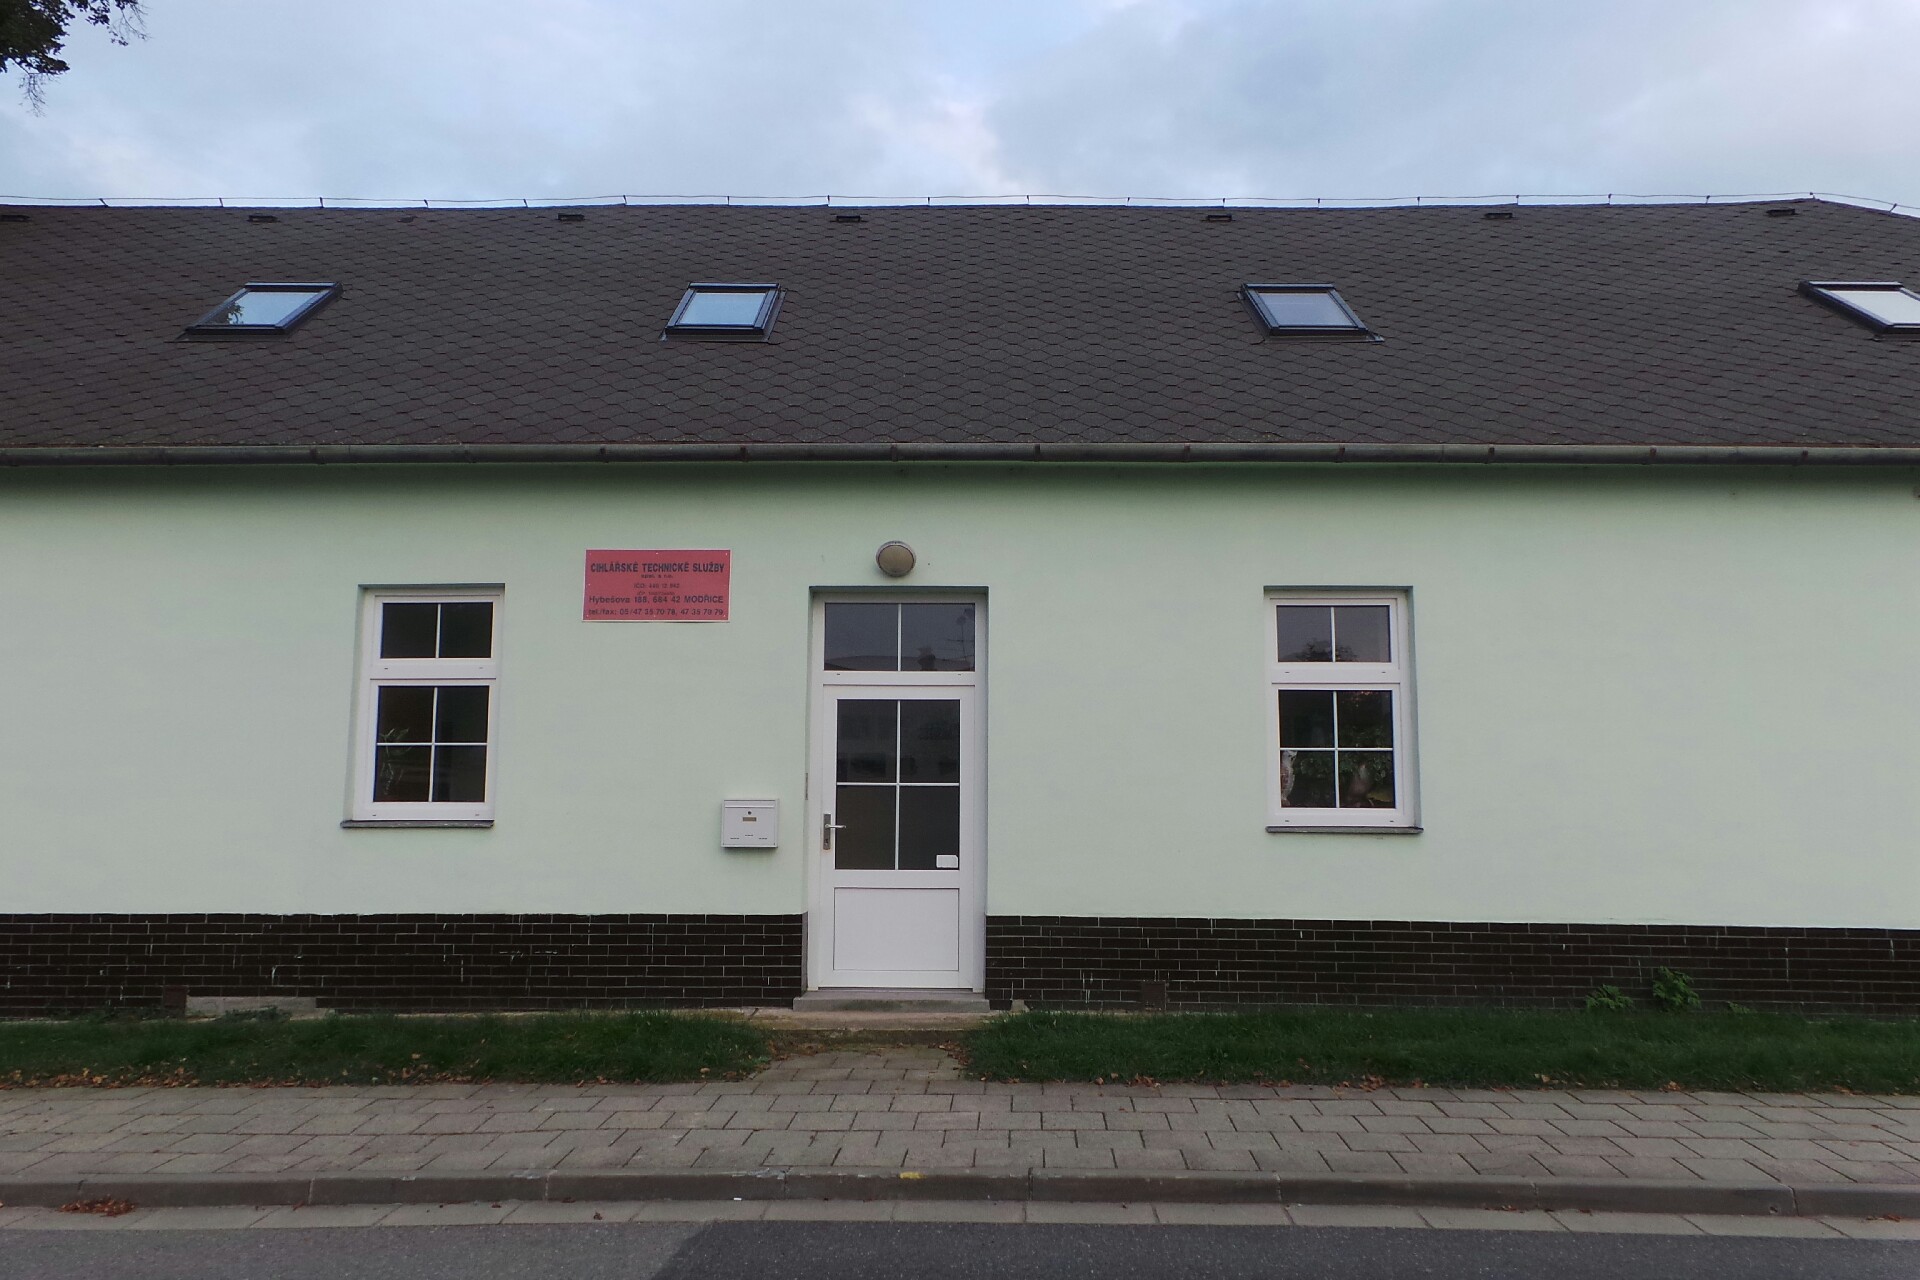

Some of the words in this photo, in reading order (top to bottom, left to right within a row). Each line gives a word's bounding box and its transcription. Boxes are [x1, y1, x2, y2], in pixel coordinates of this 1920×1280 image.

[590, 562, 638, 572] CIHLÁŘSKÉ
[642, 562, 689, 572] TECHNICKÉ
[693, 561, 724, 573] SLUŽBY
[588, 596, 630, 604] Hybešova
[671, 596, 680, 604] 42
[684, 594, 724, 604] MODŘICE
